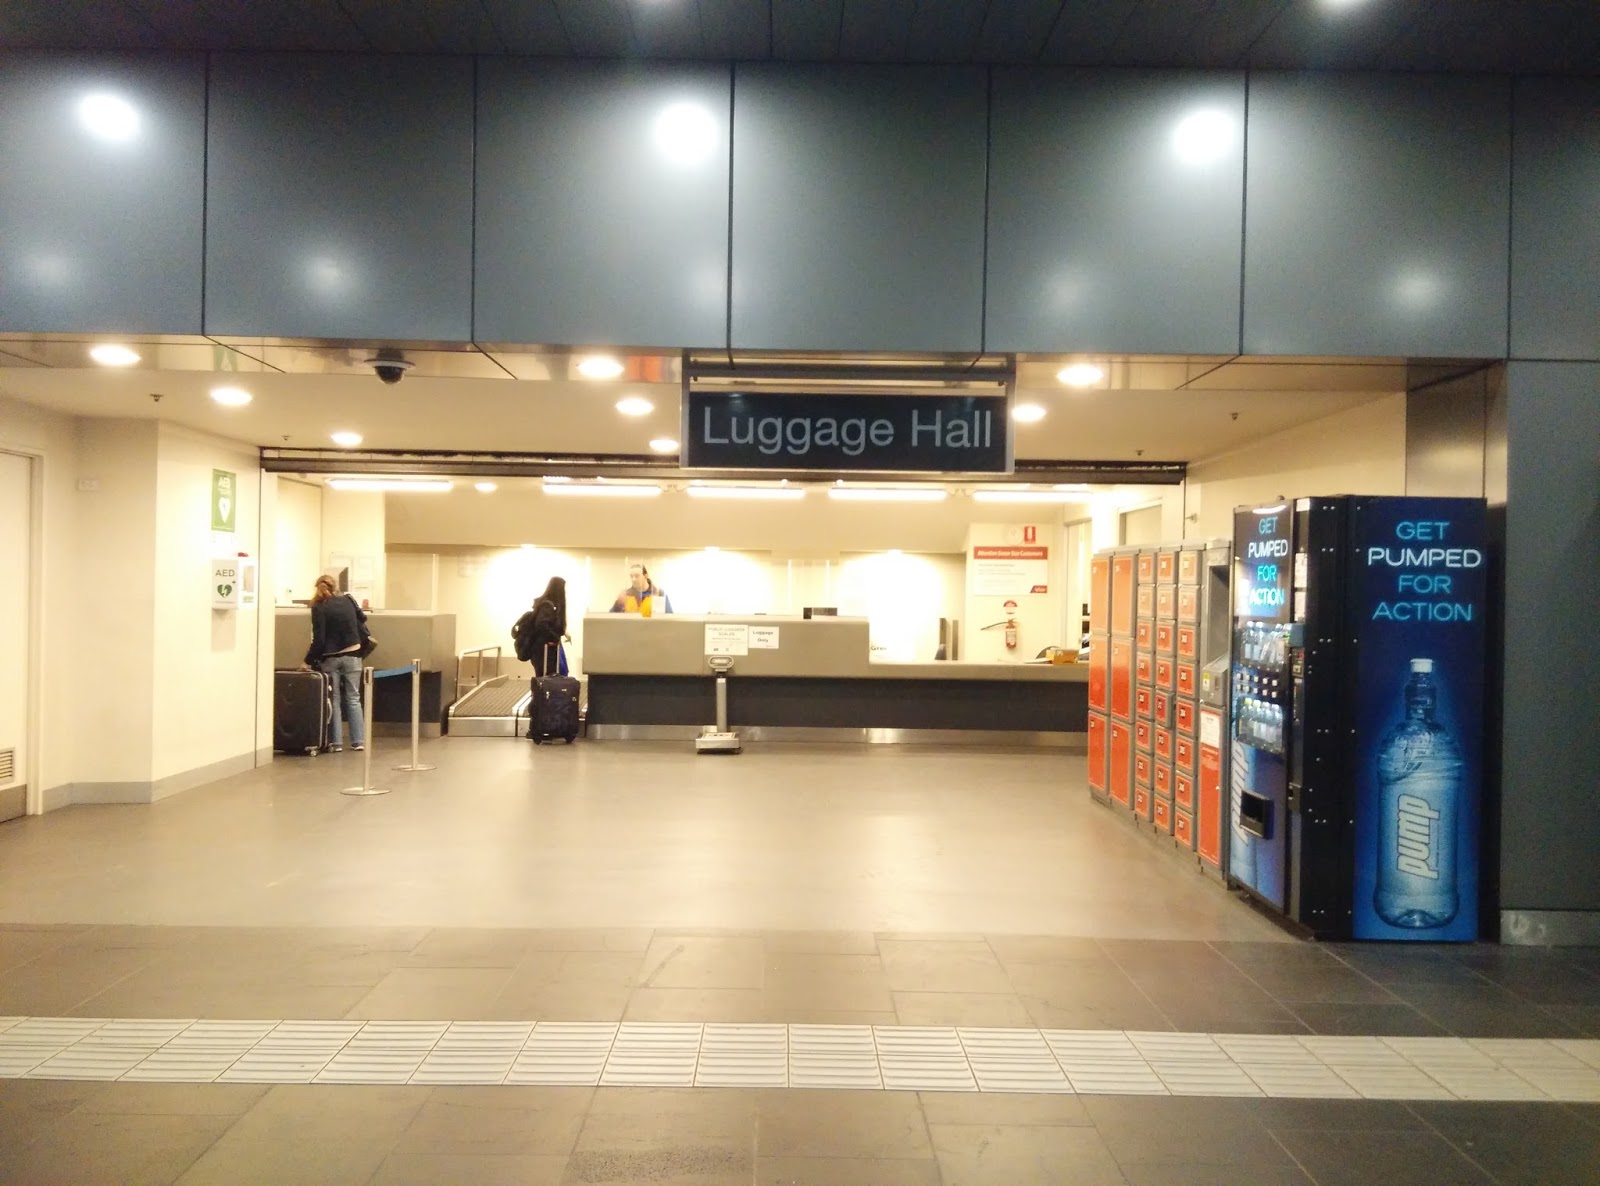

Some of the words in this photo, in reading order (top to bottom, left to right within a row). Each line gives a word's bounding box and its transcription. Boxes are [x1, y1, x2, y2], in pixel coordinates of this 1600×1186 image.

[704, 406, 895, 455] Luggage
[911, 409, 992, 448] Hall
[1258, 516, 1278, 534] GET
[1395, 521, 1450, 540] GET
[1247, 539, 1289, 558] PUMPED
[1367, 547, 1482, 568] PUMPED
[215, 569, 235, 577] AED
[1256, 564, 1277, 582] FOR
[1398, 575, 1452, 594] FOR
[1248, 587, 1285, 606] ACTION
[1371, 602, 1473, 621] ACTION
